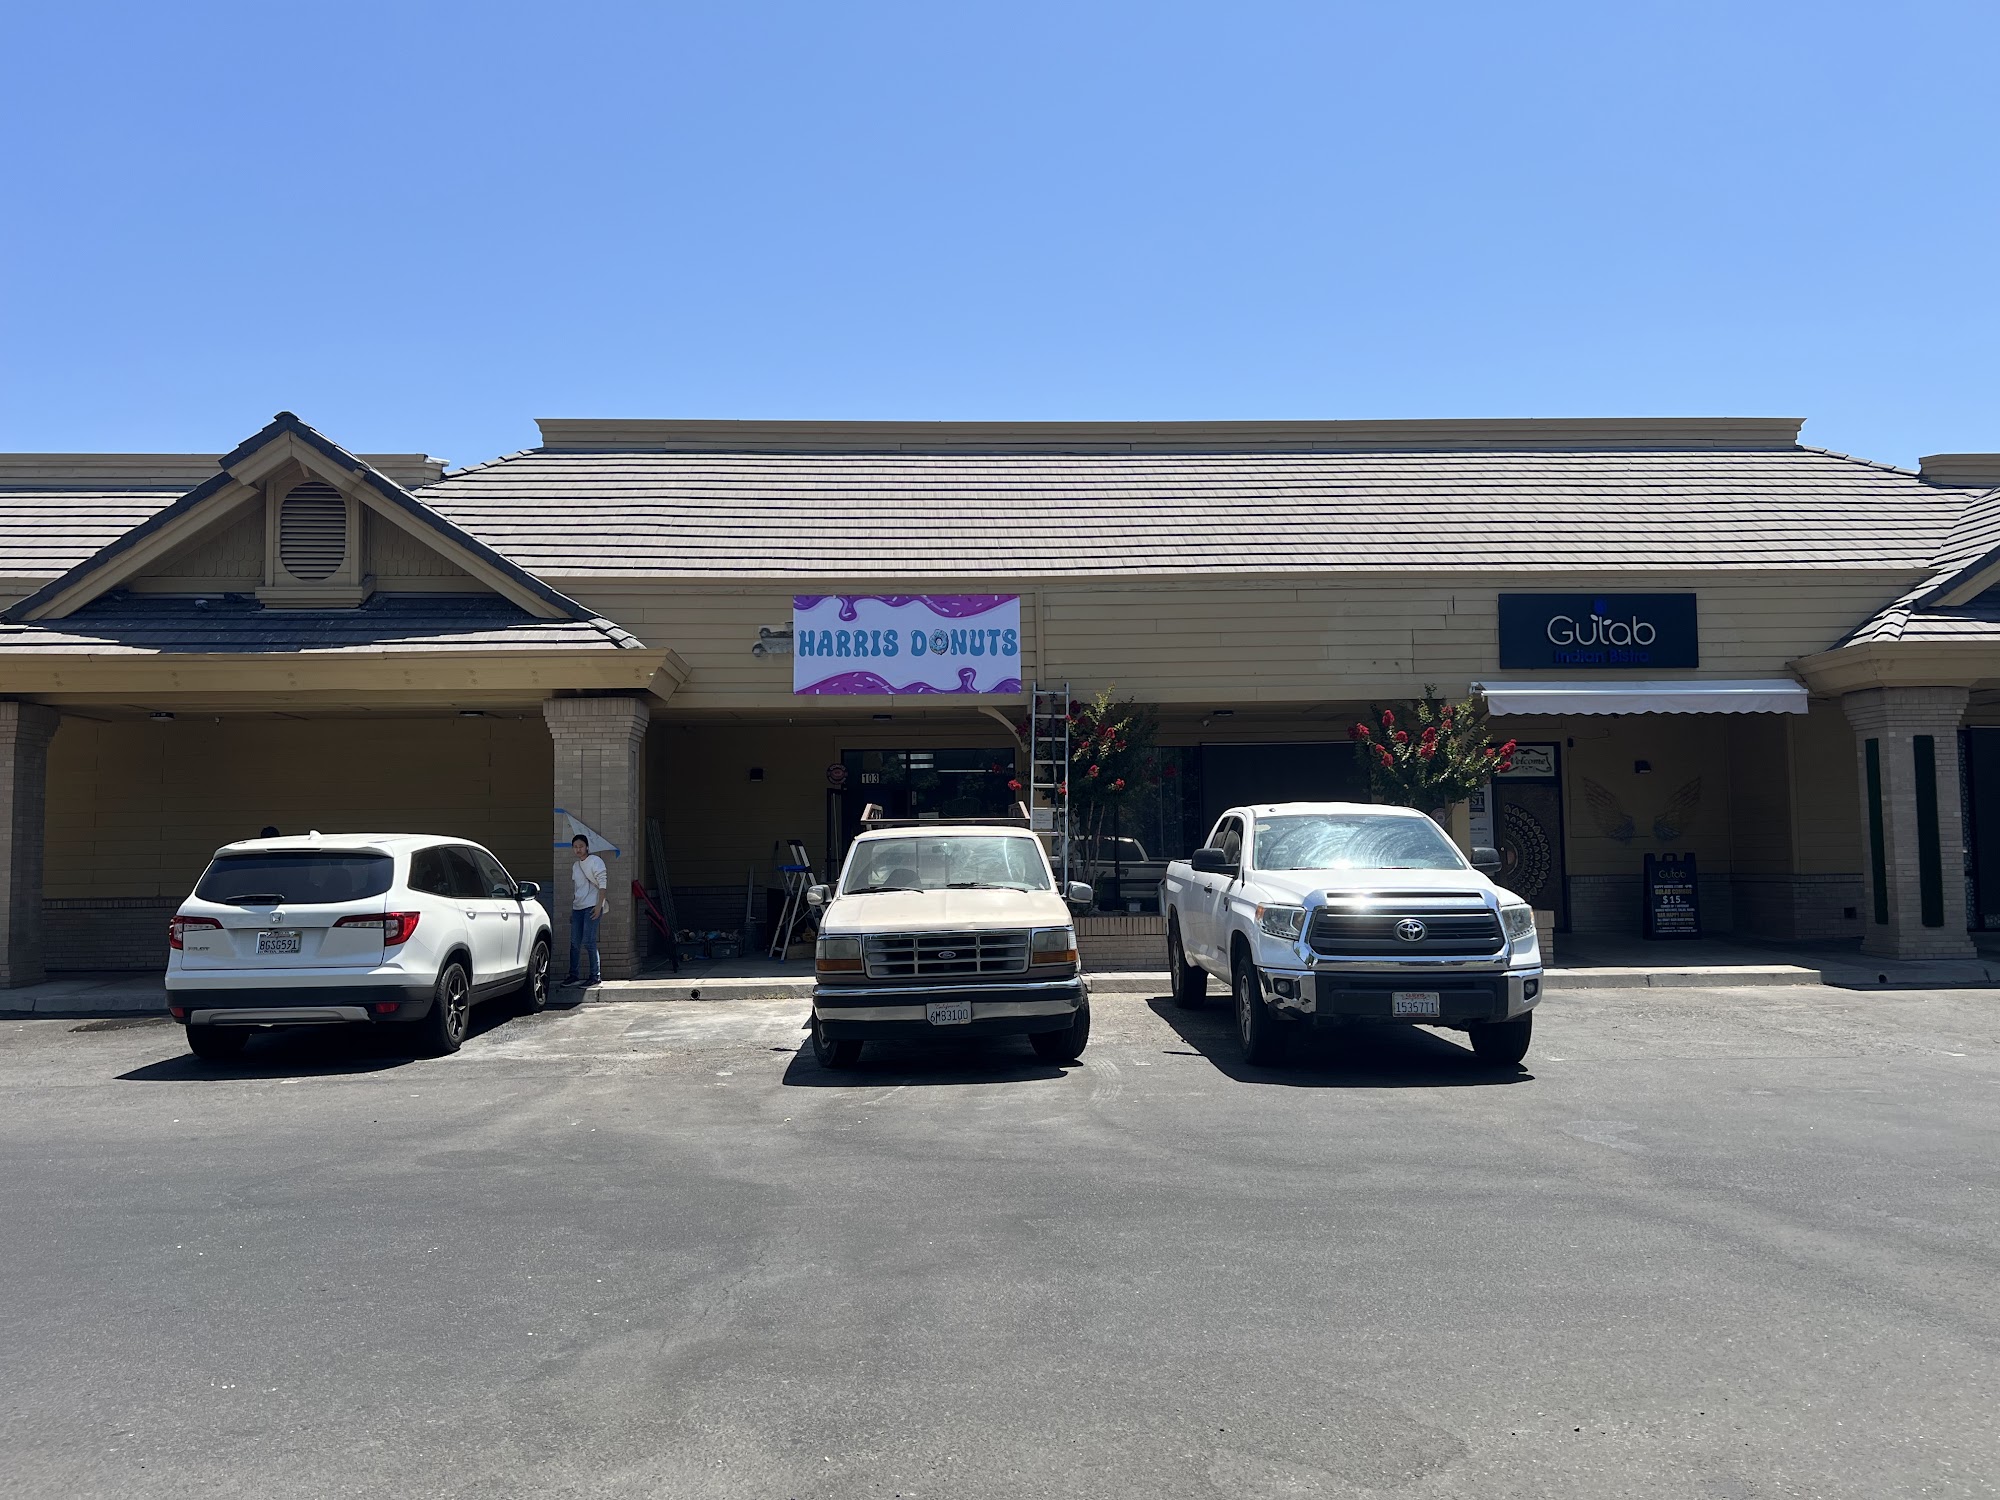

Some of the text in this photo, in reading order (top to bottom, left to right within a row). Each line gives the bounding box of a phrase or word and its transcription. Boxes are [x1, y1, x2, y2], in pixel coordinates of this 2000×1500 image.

[798, 628, 1018, 657] HARRIS DONUTS
[1554, 649, 1649, 663] Indian Bistro
[863, 773, 878, 783] 103
[1662, 895, 1681, 904] $15
